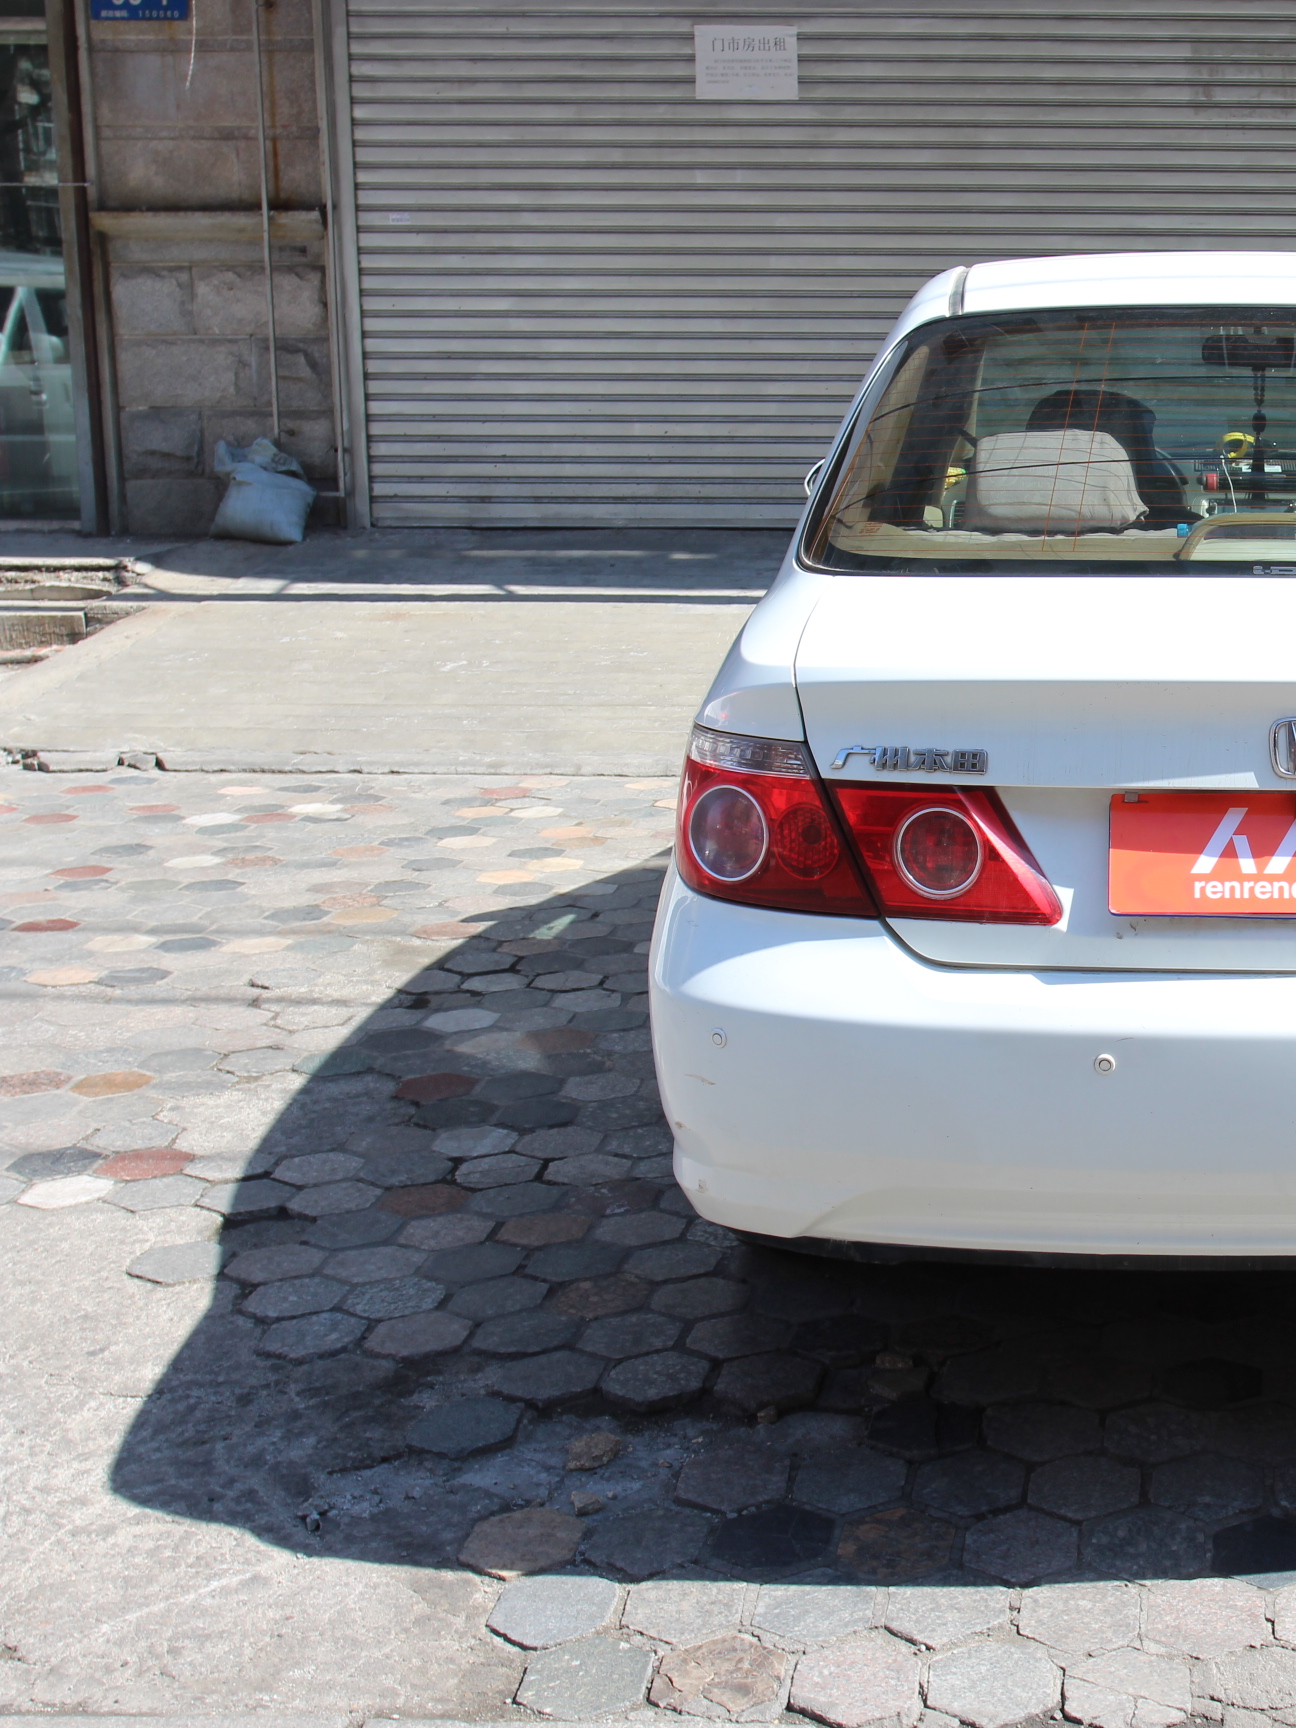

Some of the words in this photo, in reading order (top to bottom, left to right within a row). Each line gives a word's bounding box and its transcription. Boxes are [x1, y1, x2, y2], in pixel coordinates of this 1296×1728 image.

[711, 36, 787, 53] 门市房出租
[831, 745, 988, 775] 广州本田
